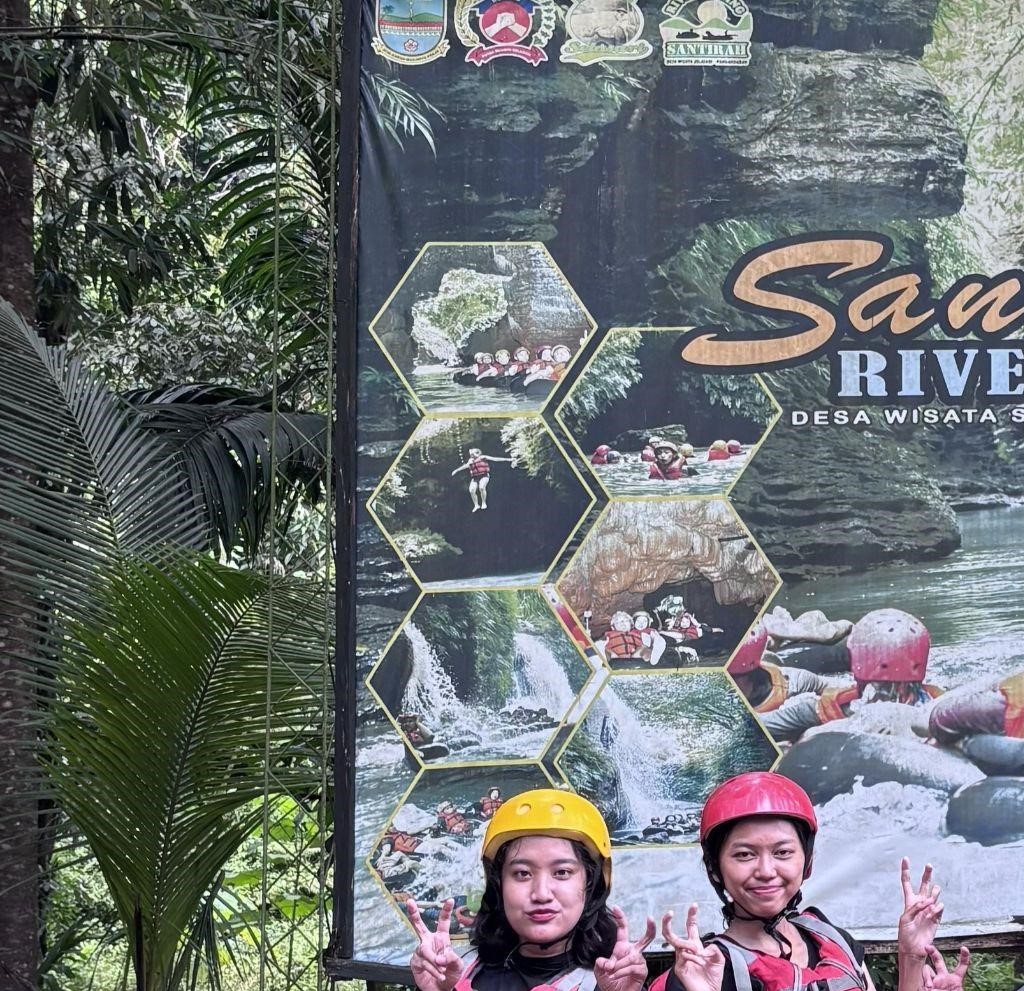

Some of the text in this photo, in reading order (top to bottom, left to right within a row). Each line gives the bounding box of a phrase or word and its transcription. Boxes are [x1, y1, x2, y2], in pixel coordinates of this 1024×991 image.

[665, 42, 747, 56] SANTIRAH
[791, 409, 872, 426] DESA
[884, 408, 998, 425] WISATA
